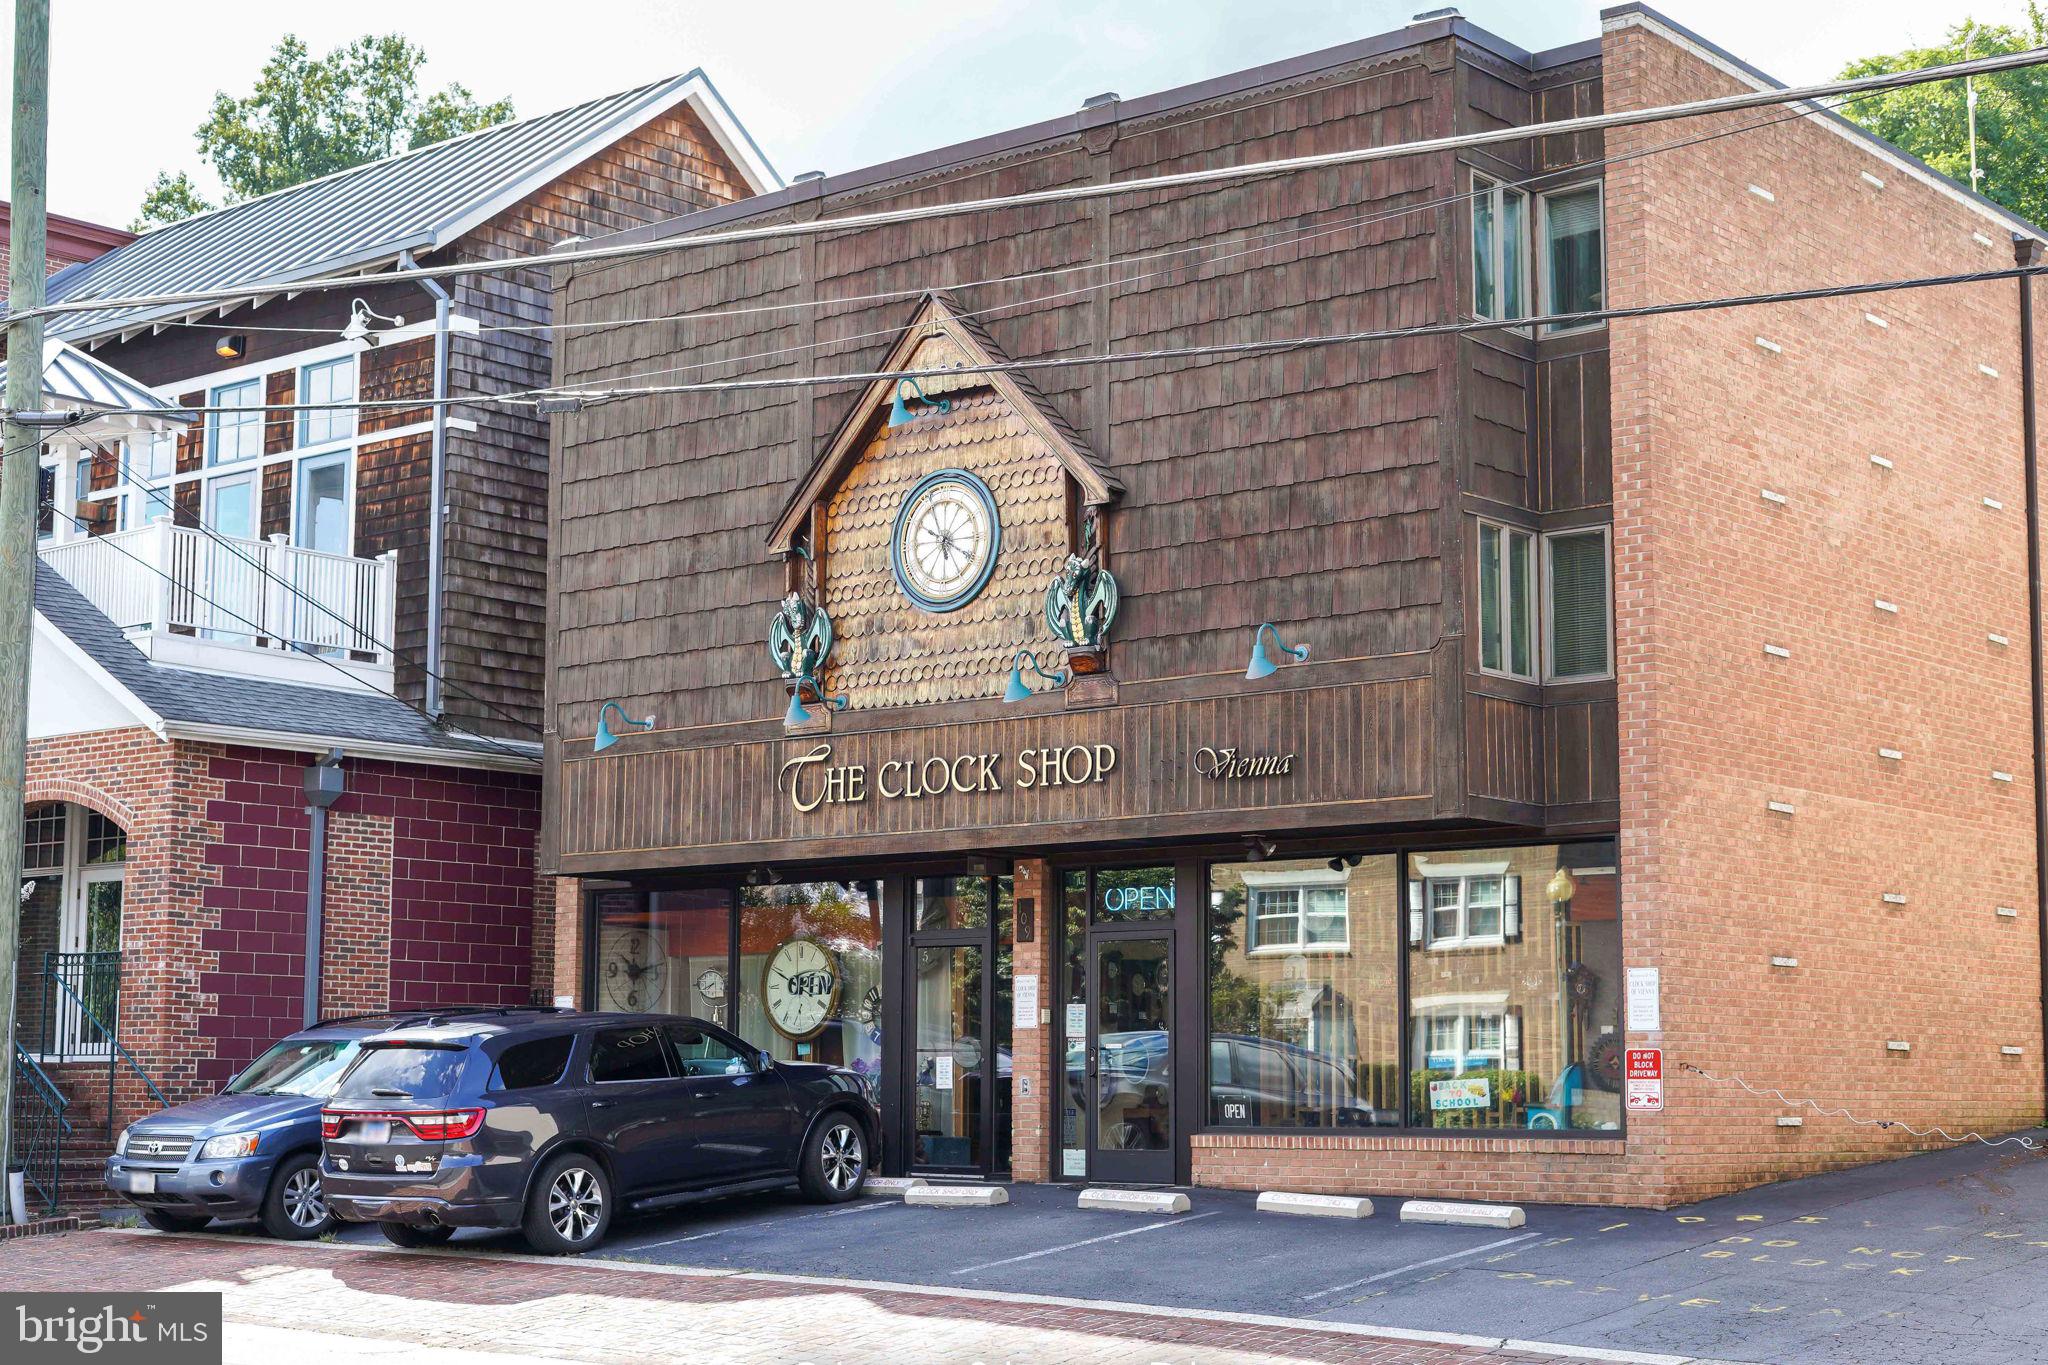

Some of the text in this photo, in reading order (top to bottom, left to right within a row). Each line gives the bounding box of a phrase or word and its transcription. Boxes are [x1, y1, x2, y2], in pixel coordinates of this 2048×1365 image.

[1193, 747, 1295, 780] Vienna
[778, 744, 1116, 812] THE CLOCK SHOP
[1105, 886, 1175, 911] OPEN
[788, 970, 834, 996] OPEN
[1632, 1052, 1655, 1060] DO NOT
[1634, 1061, 1654, 1069] BLOCK
[1438, 1081, 1467, 1090] BACK
[1449, 1089, 1463, 1097] TO
[1435, 1098, 1479, 1108] SCHOOL
[1224, 1103, 1246, 1119] OPEN
[1719, 1236, 1799, 1248] DO
[1700, 1250, 1926, 1277] BLOCK
